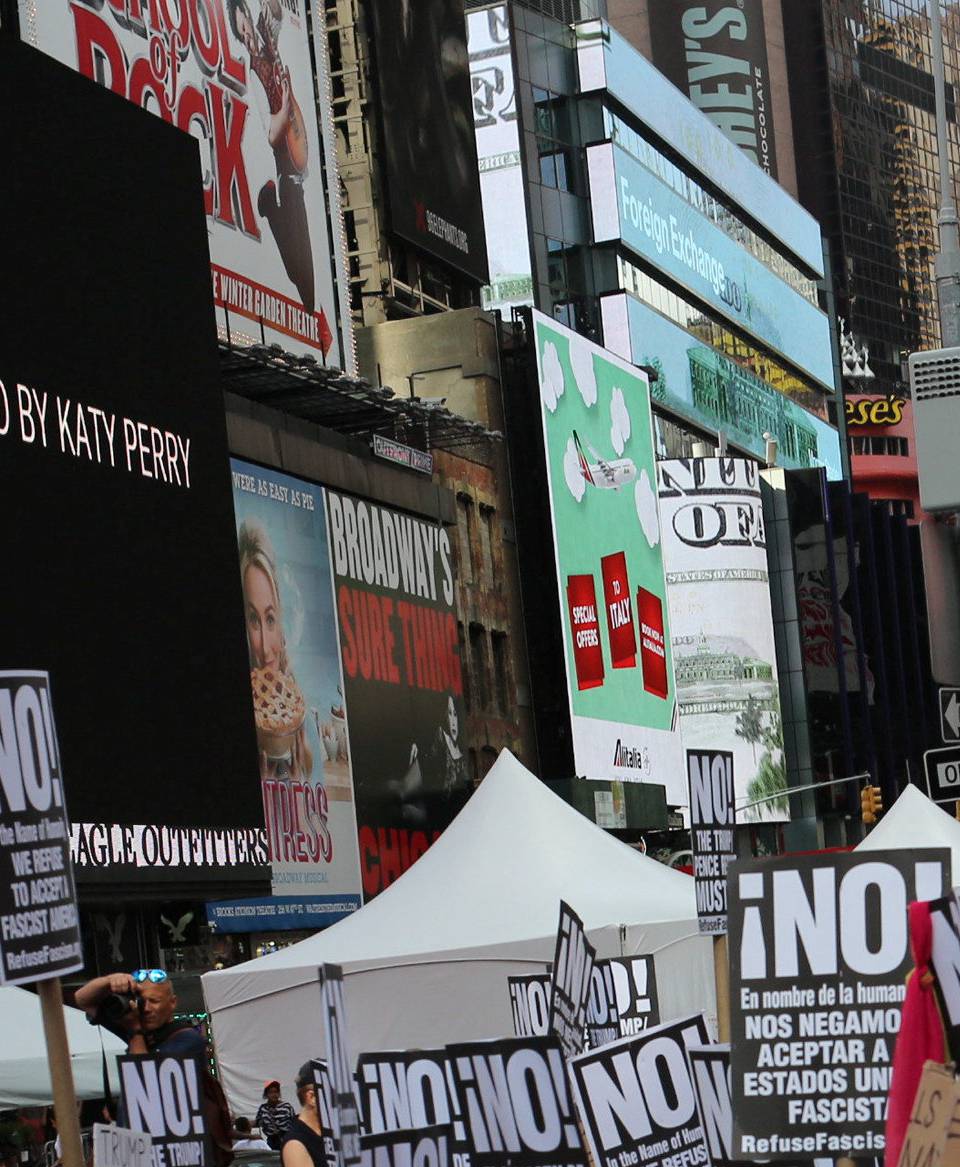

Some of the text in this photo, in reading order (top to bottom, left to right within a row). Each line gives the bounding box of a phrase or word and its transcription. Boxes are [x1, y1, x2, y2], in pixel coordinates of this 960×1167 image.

[149, 32, 182, 110] of
[620, 175, 726, 291] Foreign Exchange
[220, 274, 253, 311] WINTER
[254, 289, 288, 328] GARDEN
[287, 301, 320, 342] THEATRE
[17, 383, 47, 447] BY
[57, 396, 115, 467] KATY
[124, 418, 190, 489] PERRY
[232, 472, 314, 512] WERE AS EASY AS PIE
[329, 492, 454, 607] BROADWAY'S
[612, 580, 620, 596] TO
[573, 605, 596, 624] SPECIAL
[610, 598, 631, 630] ITALY
[338, 584, 464, 697] SURE THING
[577, 629, 599, 649] OFFERS
[613, 738, 642, 769] Alitalia
[689, 754, 734, 826] NO!
[696, 829, 712, 852] THE
[694, 855, 720, 877] PENCE
[11, 882, 28, 908] TO
[1, 911, 49, 941] FASCIST
[741, 983, 853, 1010] En nombre de la
[745, 1014, 793, 1039] NOS
[757, 1038, 890, 1068] ACEPTAR A
[121, 1057, 205, 1138] NO!
[743, 1068, 848, 1097] ESTADOS
[456, 1049, 581, 1153] ¡NO!
[618, 1151, 638, 1167] the
[638, 1141, 669, 1162] Name
[670, 1135, 682, 1152] of
